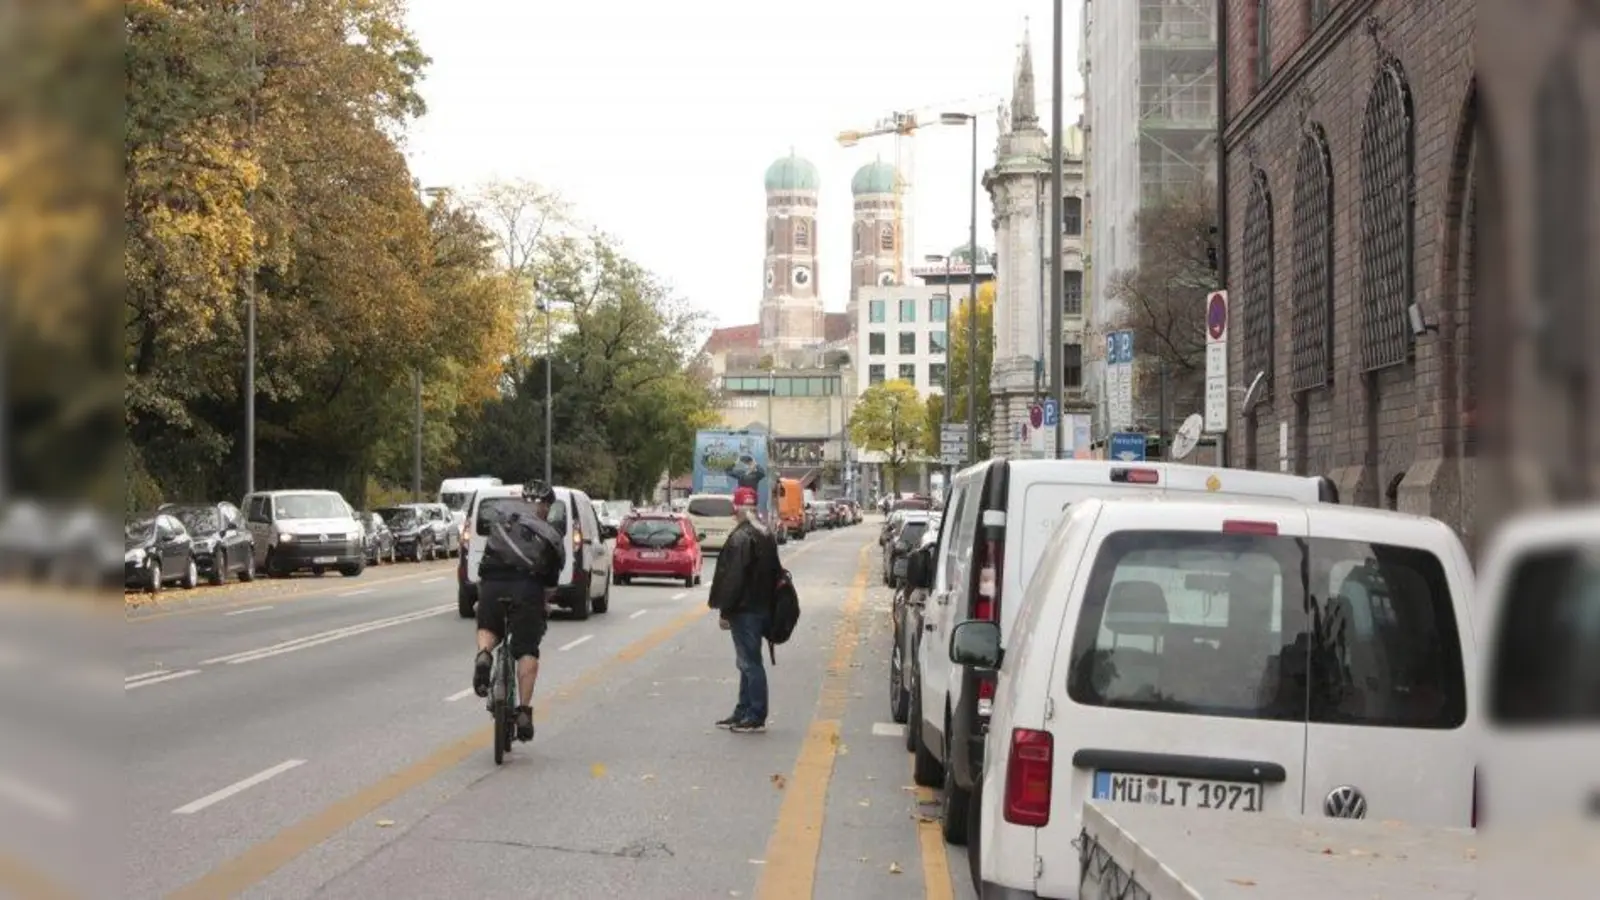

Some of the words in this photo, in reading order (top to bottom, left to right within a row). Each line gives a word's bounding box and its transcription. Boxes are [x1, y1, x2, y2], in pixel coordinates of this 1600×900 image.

[1046, 403, 1055, 425] P
[1111, 776, 1142, 803] MÜ
[1161, 779, 1192, 807] LT
[1197, 782, 1256, 812] 1971
